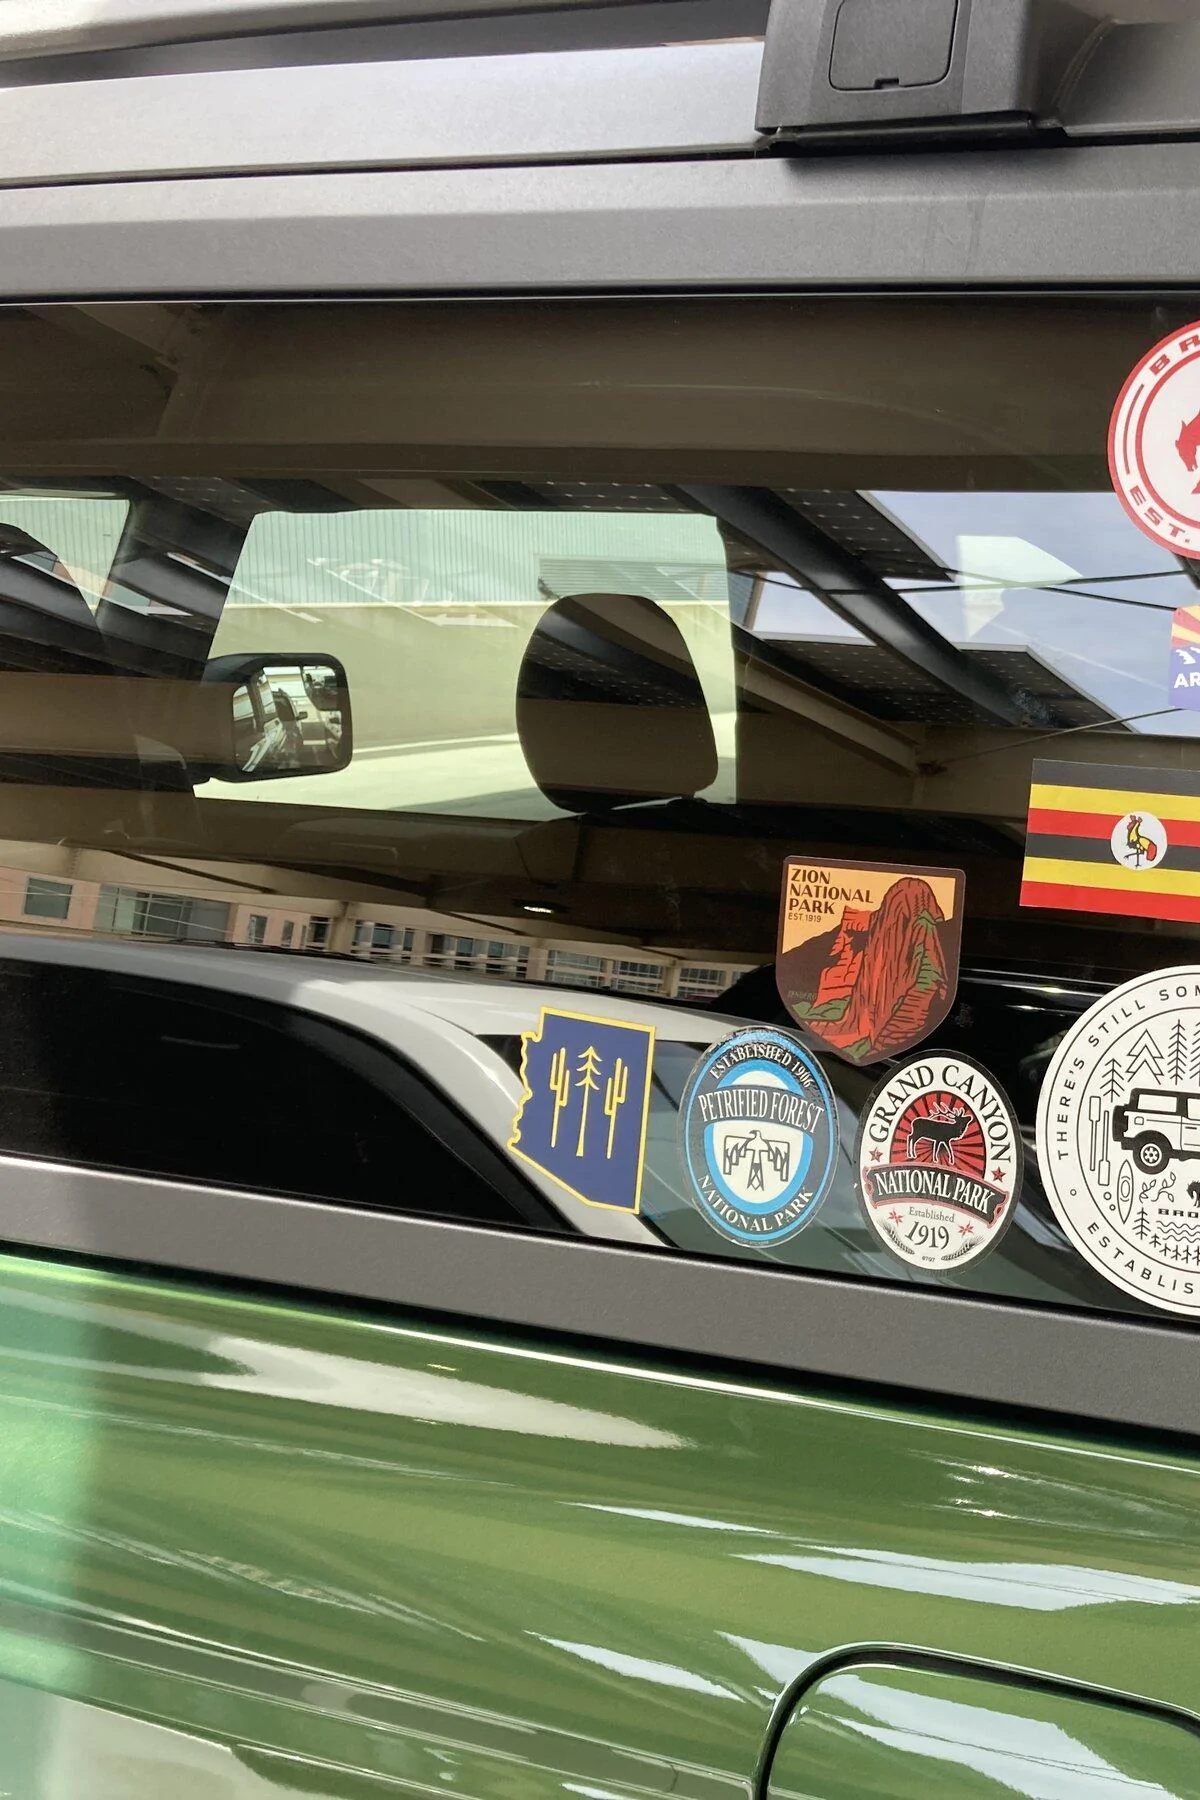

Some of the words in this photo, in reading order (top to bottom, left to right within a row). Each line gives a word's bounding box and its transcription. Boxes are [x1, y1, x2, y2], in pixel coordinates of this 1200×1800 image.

[1129, 484, 1190, 543] EST.
[789, 883, 874, 904] NATIONAL
[791, 868, 831, 885] ZION
[788, 898, 835, 915] PARK
[709, 1043, 792, 1080] ESTABLISHED
[791, 1061, 815, 1088] 1906
[1056, 1056, 1085, 1160] THERE'S
[1088, 999, 1146, 1048] STILL
[698, 1088, 766, 1123] PETRIFIED
[770, 1092, 824, 1134] FOREST
[868, 1065, 934, 1143] GRAND
[942, 1064, 1011, 1163] CANYON
[698, 1174, 773, 1232] NATIONAL
[774, 1187, 814, 1228] PARK
[874, 1169, 951, 1201] NATIONAL
[952, 1177, 996, 1214] PARK
[904, 1221, 950, 1250] 1919
[908, 1206, 955, 1224] Established
